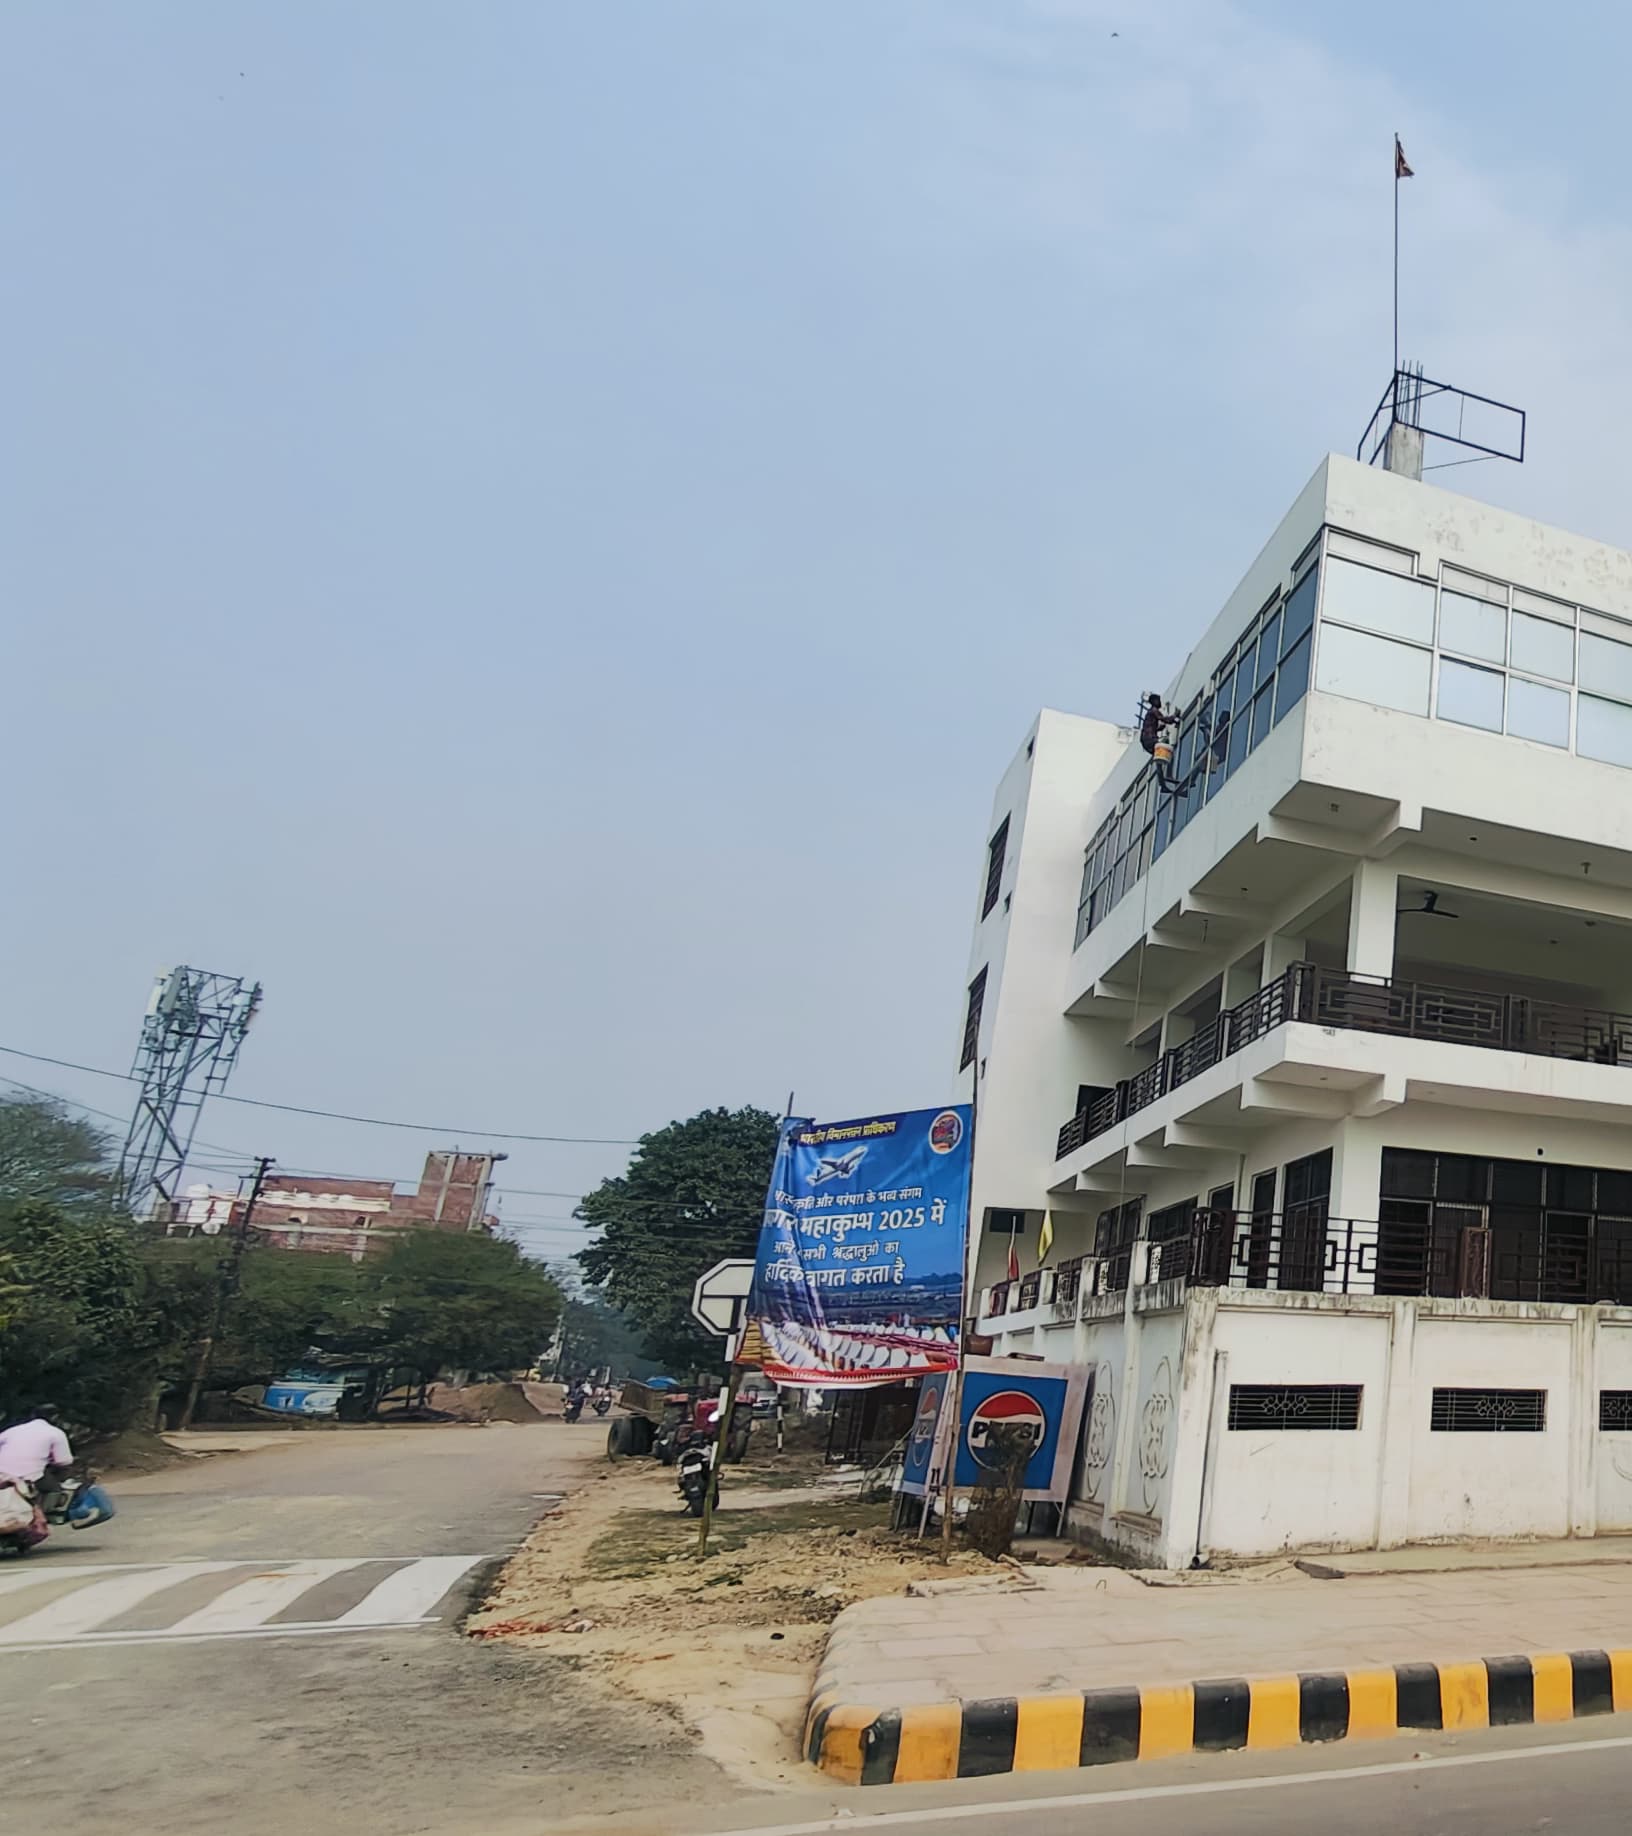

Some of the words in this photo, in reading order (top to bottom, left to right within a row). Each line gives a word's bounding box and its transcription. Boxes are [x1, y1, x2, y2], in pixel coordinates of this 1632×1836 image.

[815, 1191, 833, 1208] और
[866, 1189, 877, 1203] के
[898, 1186, 923, 1200] संगम
[800, 1212, 874, 1242] महाकुम्भ
[878, 1206, 925, 1231] 2025
[930, 1198, 947, 1225] में
[884, 1240, 900, 1256] का
[806, 1268, 848, 1288] वागत
[850, 1263, 891, 1286] करता
[893, 1256, 905, 1285] है
